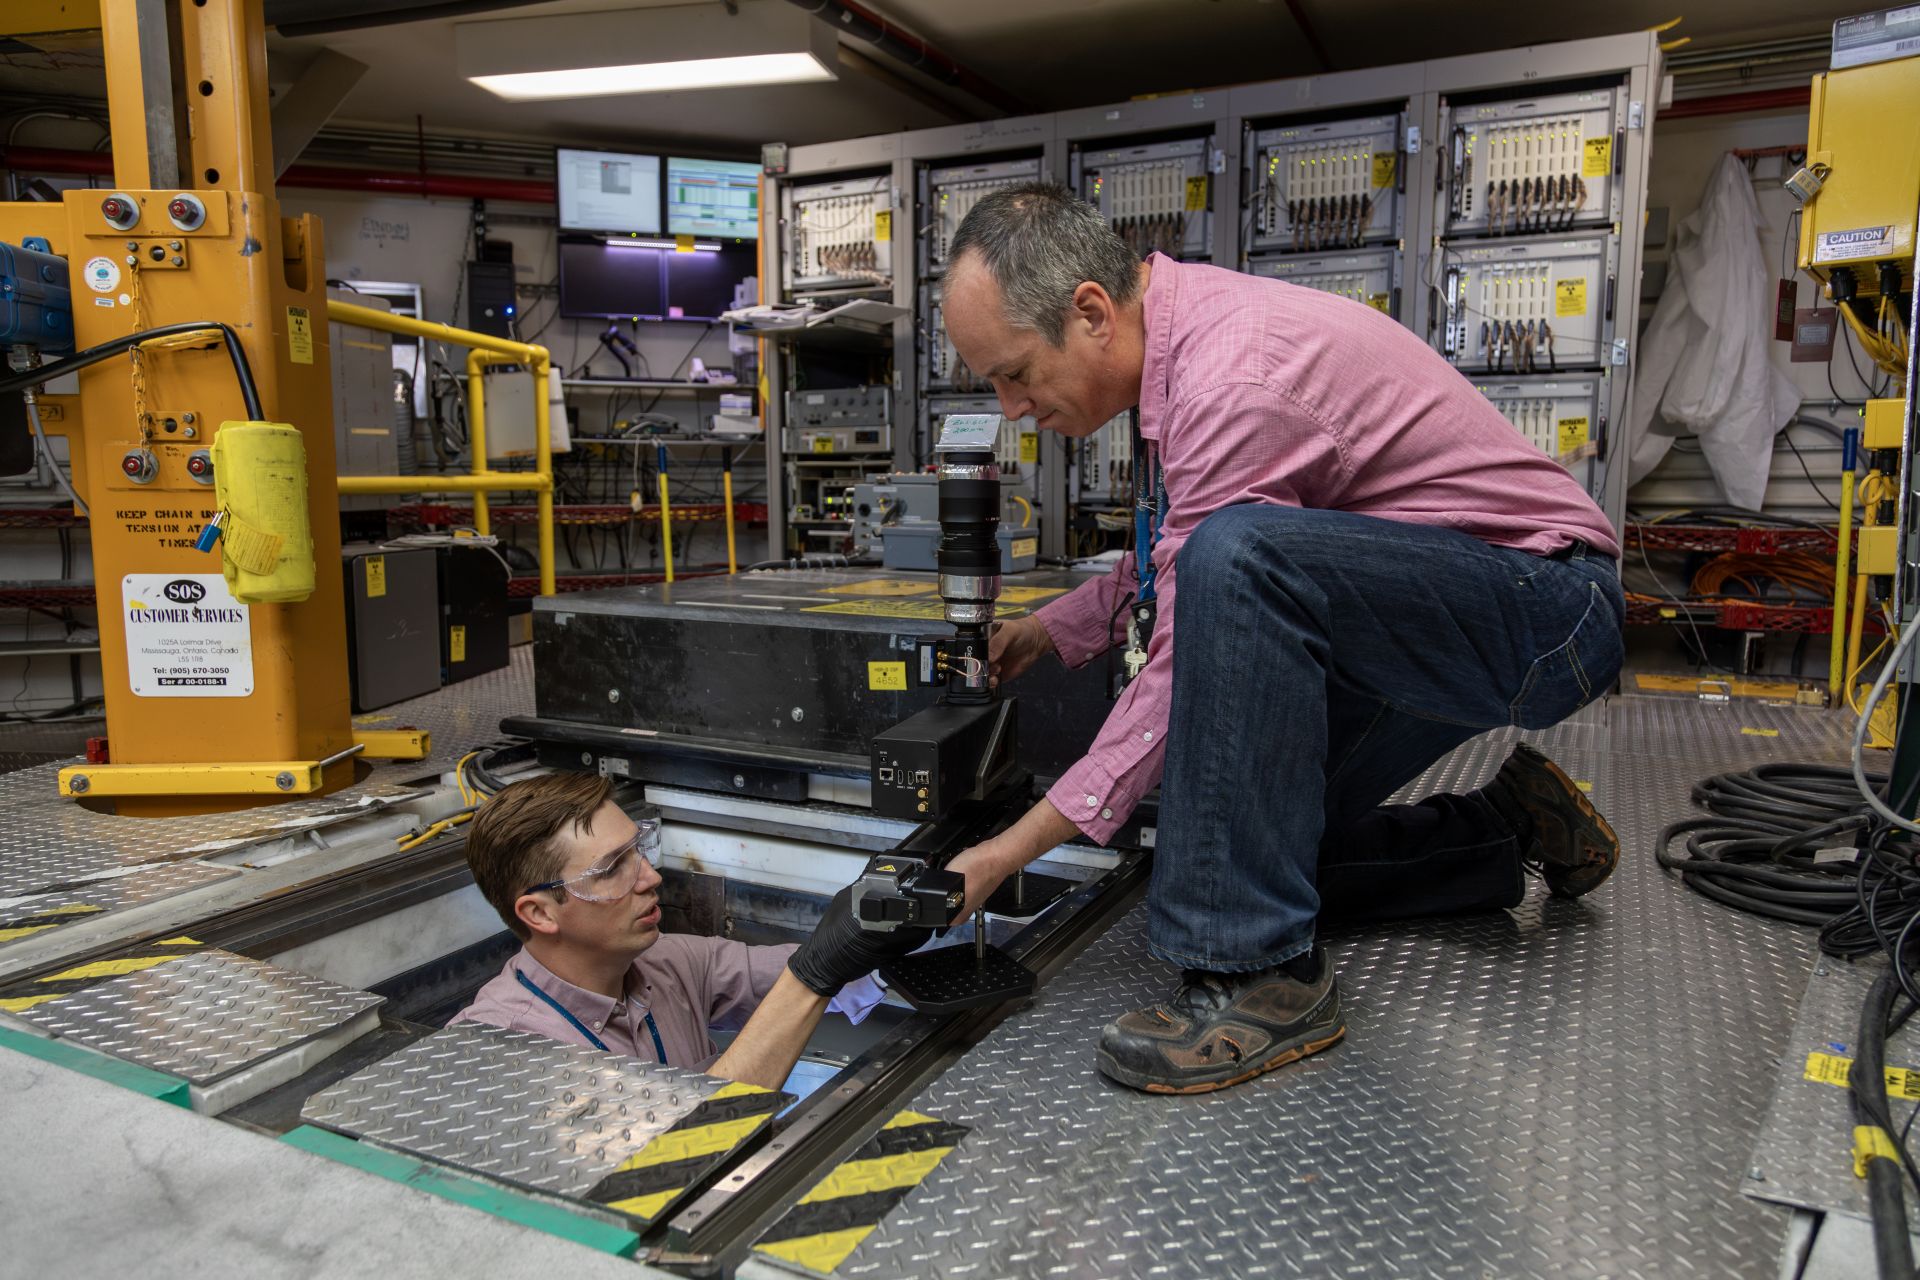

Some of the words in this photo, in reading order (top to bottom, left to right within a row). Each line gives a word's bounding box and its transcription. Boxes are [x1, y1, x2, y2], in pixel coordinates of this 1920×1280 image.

[1829, 229, 1882, 244] CAUTION
[116, 510, 147, 519] KEEP
[155, 510, 193, 519] CHAIN
[126, 524, 179, 533] TENSION
[187, 524, 201, 533] AT
[158, 539, 197, 548] TIMES
[168, 584, 202, 600] SOS
[130, 607, 189, 623] CUSTOMER
[192, 607, 243, 623] SERVICES
[169, 667, 190, 675] (905)
[876, 676, 898, 685] 4652
